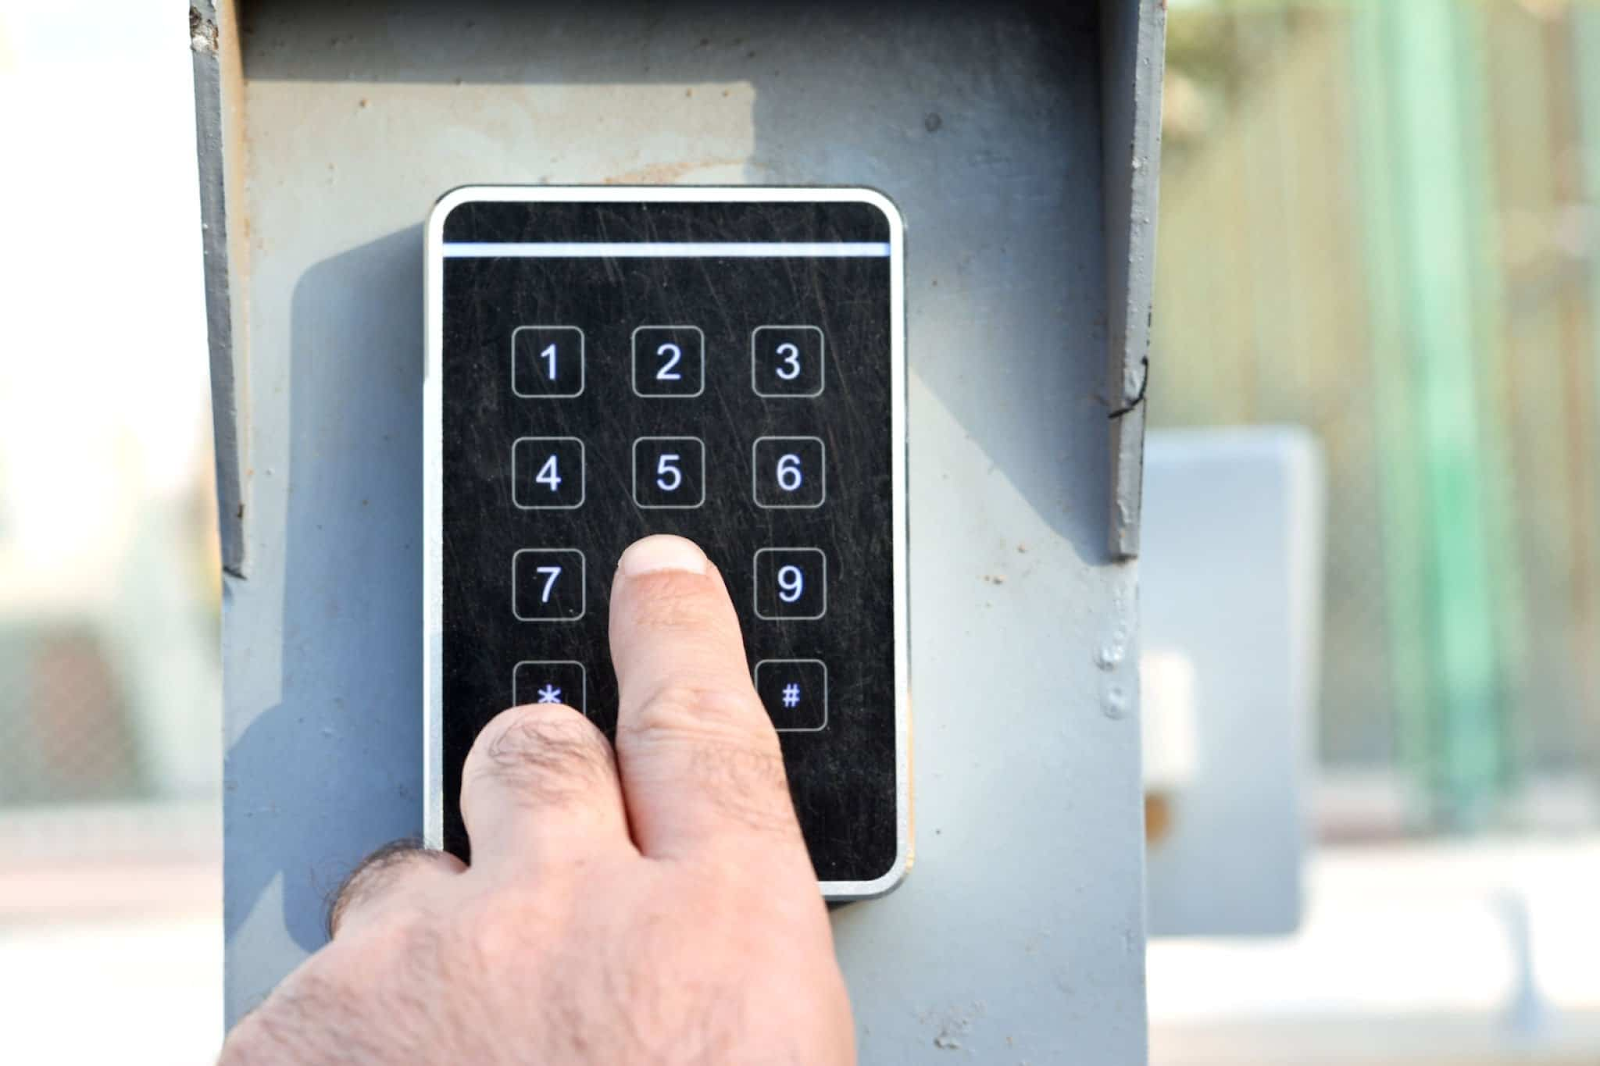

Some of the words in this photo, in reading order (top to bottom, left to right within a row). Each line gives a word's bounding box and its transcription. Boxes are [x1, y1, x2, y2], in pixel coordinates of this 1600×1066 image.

[540, 344, 556, 380] 1
[656, 343, 681, 380] 2
[776, 343, 801, 380] 3
[535, 455, 562, 491] 4
[657, 454, 682, 491] 5
[776, 453, 802, 491] 6
[536, 566, 561, 603] 7
[777, 565, 803, 603] 9
[782, 683, 801, 707] #
